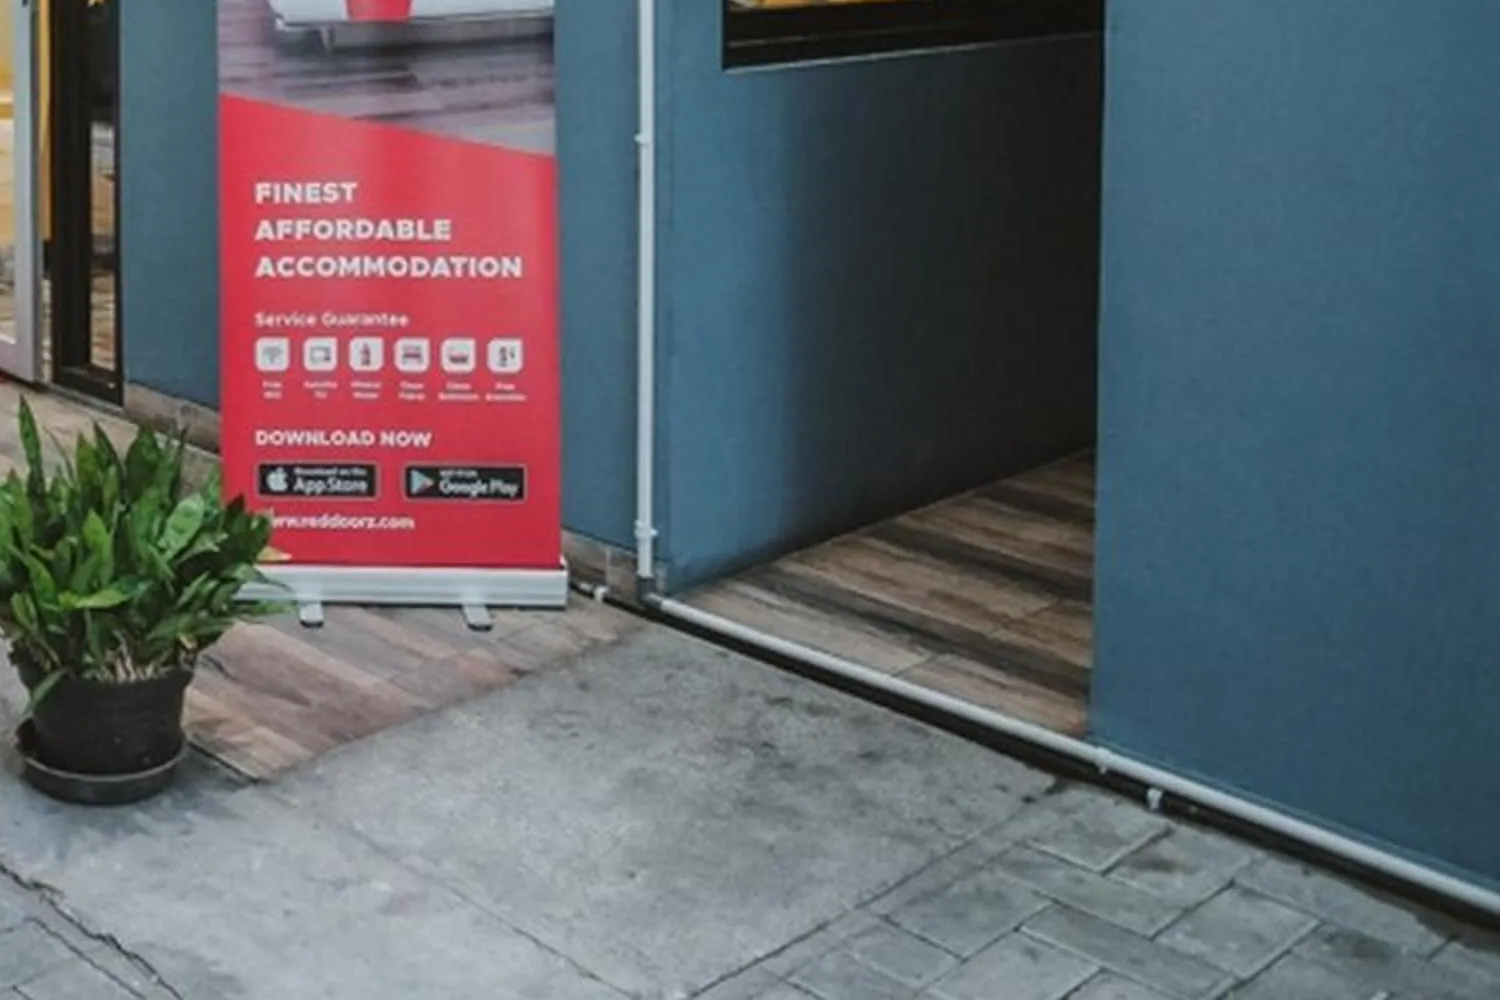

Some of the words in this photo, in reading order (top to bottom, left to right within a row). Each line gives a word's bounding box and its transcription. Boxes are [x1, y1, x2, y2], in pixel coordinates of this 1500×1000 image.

[255, 182, 357, 204] FINEST
[255, 220, 452, 241] AFFORDABLE
[255, 256, 524, 278] ACCOMMODATION
[255, 312, 317, 328] Service
[321, 312, 410, 328] Guarantee
[255, 430, 375, 447] DOWNLOAD
[380, 430, 432, 448] NOW
[293, 477, 325, 496] App
[326, 477, 368, 494] Store
[439, 477, 488, 498] Google
[489, 478, 519, 498] Play
